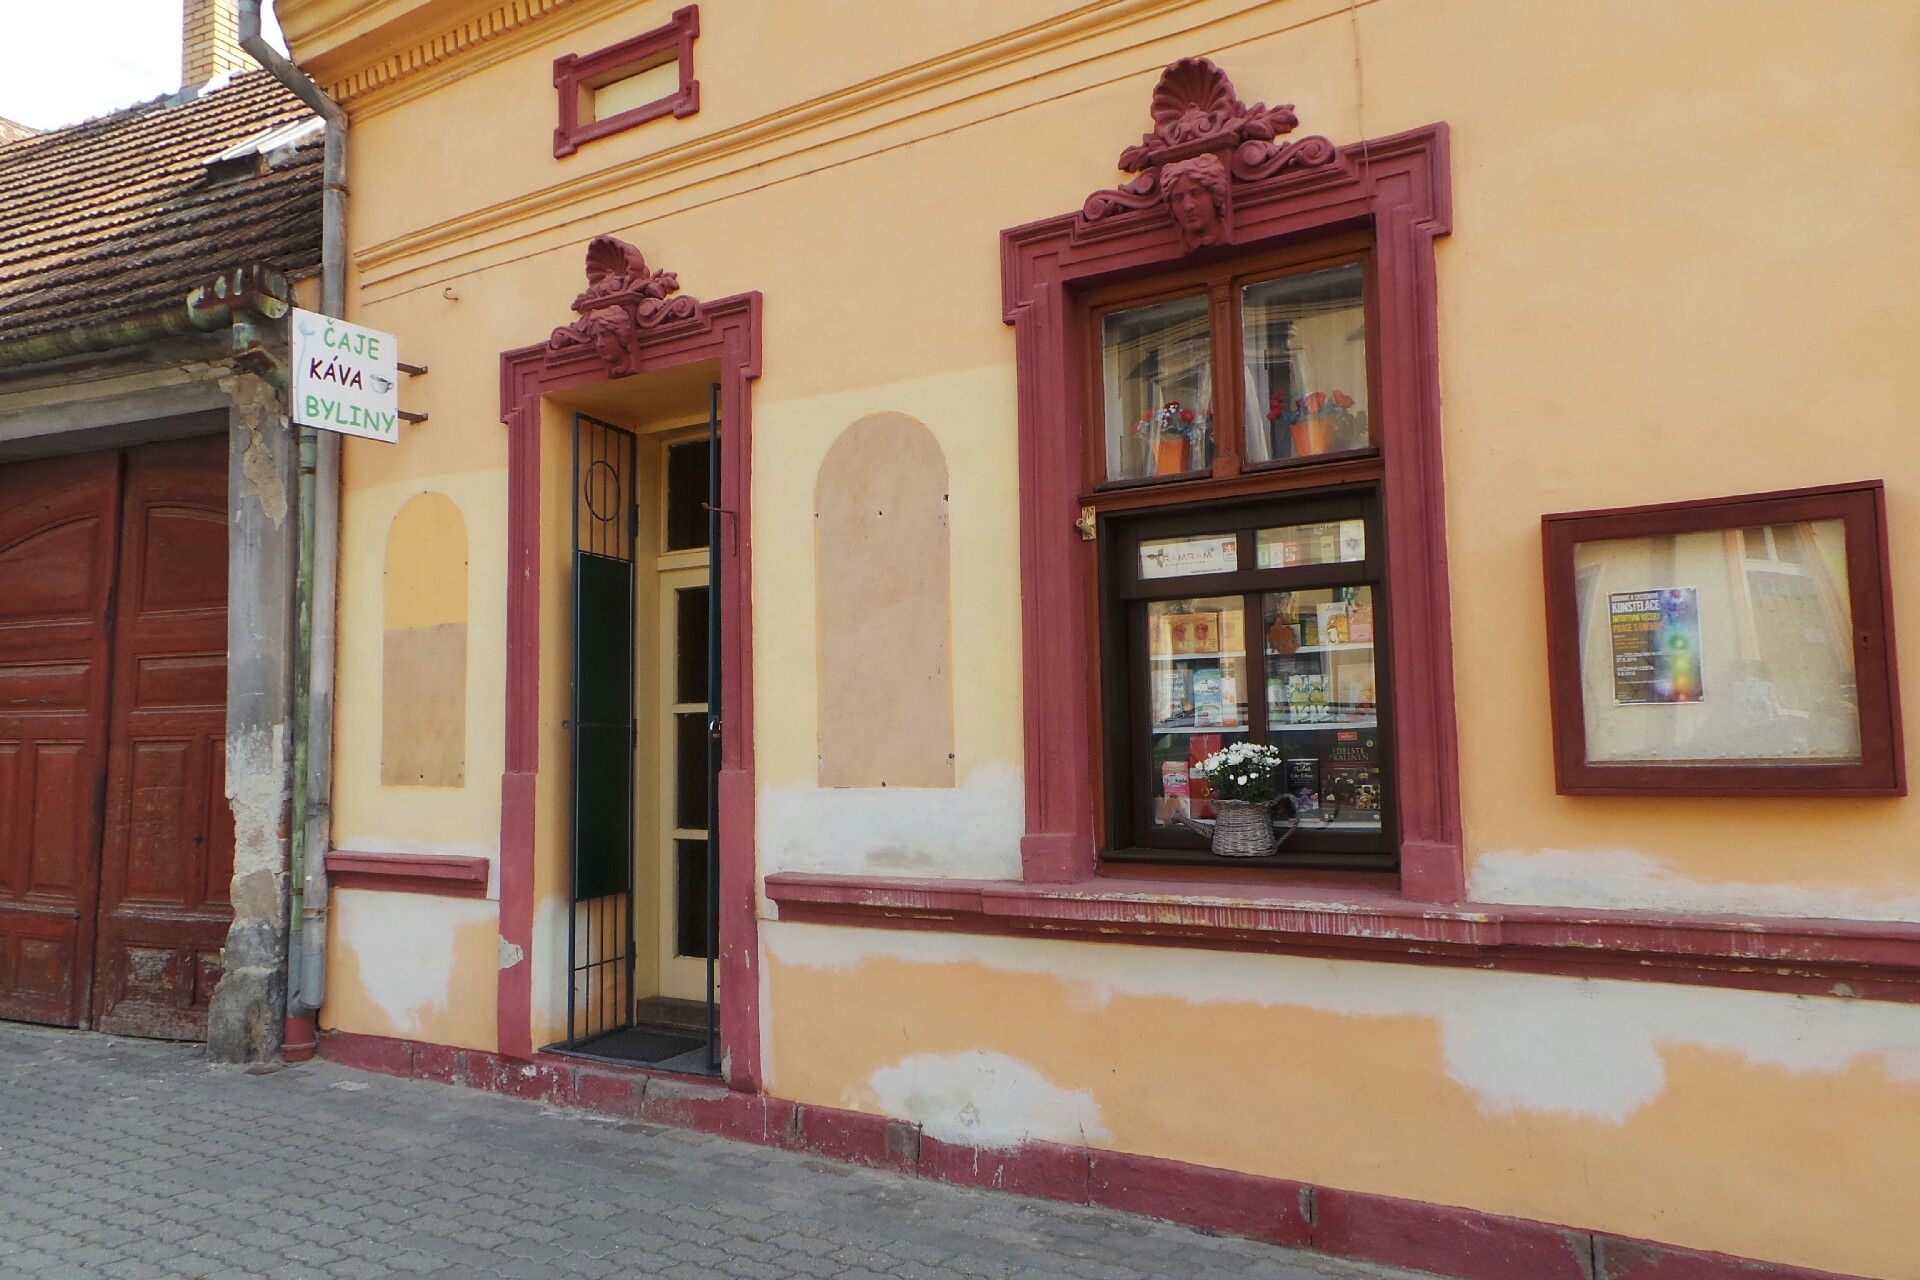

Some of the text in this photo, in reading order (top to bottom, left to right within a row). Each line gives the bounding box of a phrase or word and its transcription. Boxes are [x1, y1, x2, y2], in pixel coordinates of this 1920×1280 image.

[323, 318, 380, 360] ČAJE
[309, 355, 363, 390] KÁVA
[306, 395, 395, 433] BYLINY
[1612, 600, 1660, 613] KONSTELACE
[1328, 753, 1369, 761] PRALINEN
[1332, 747, 1365, 755] EDELSTE
